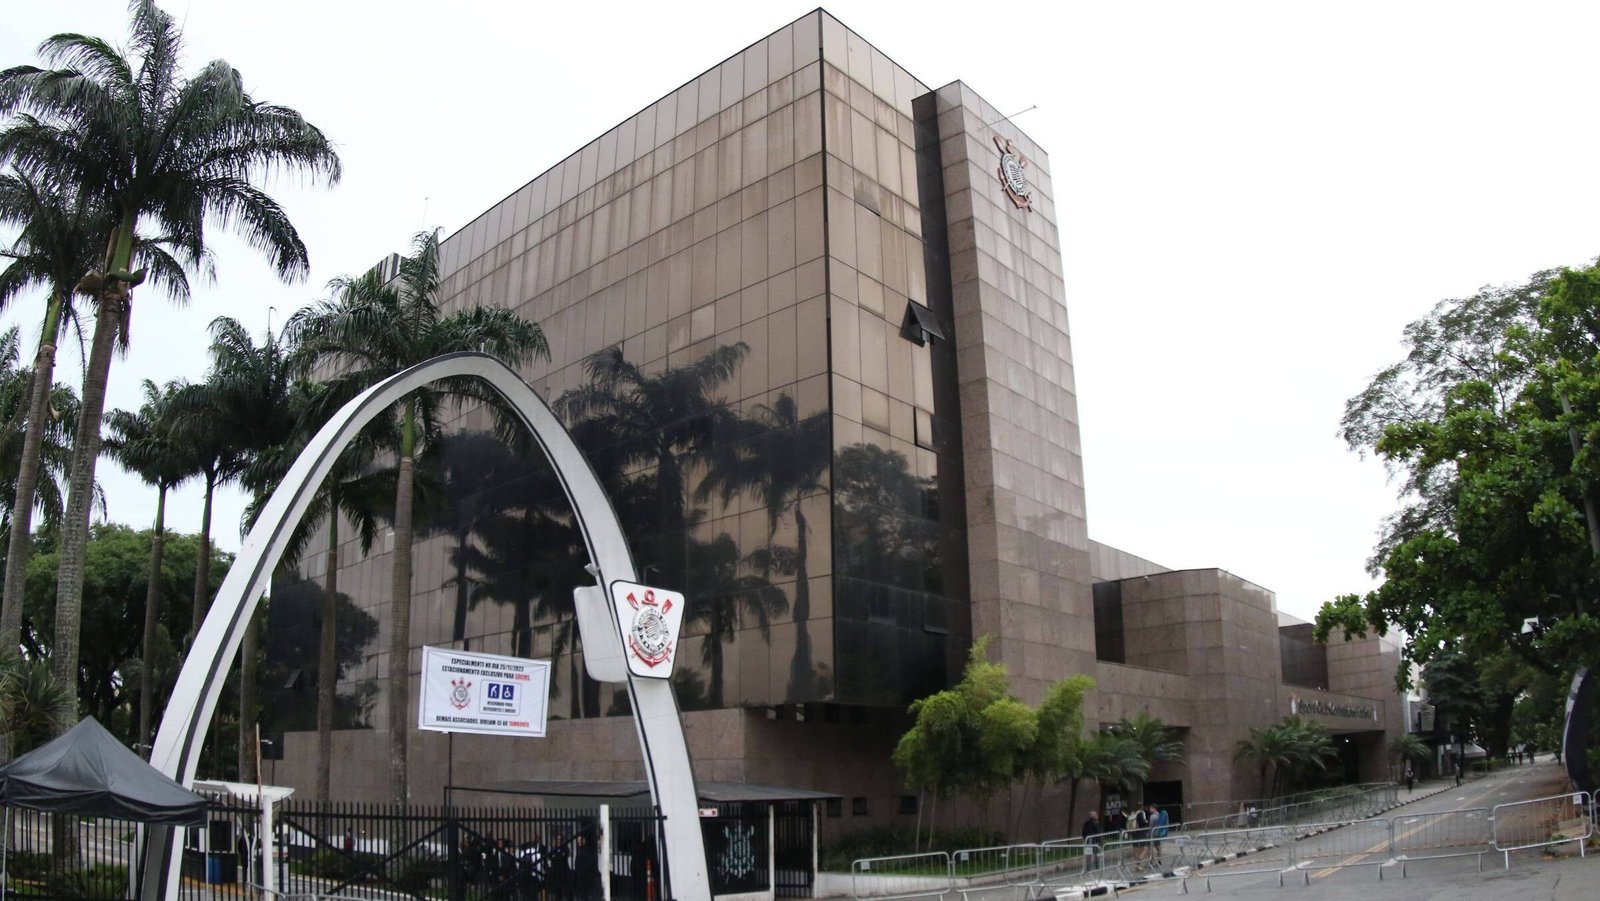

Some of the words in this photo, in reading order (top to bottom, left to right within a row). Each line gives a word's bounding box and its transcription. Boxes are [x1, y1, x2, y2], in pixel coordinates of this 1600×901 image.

[451, 658, 484, 668] ESPECIALMENTE
[442, 665, 480, 676] ESTACIONAMENTO
[480, 669, 503, 678] EXCLUSIVO
